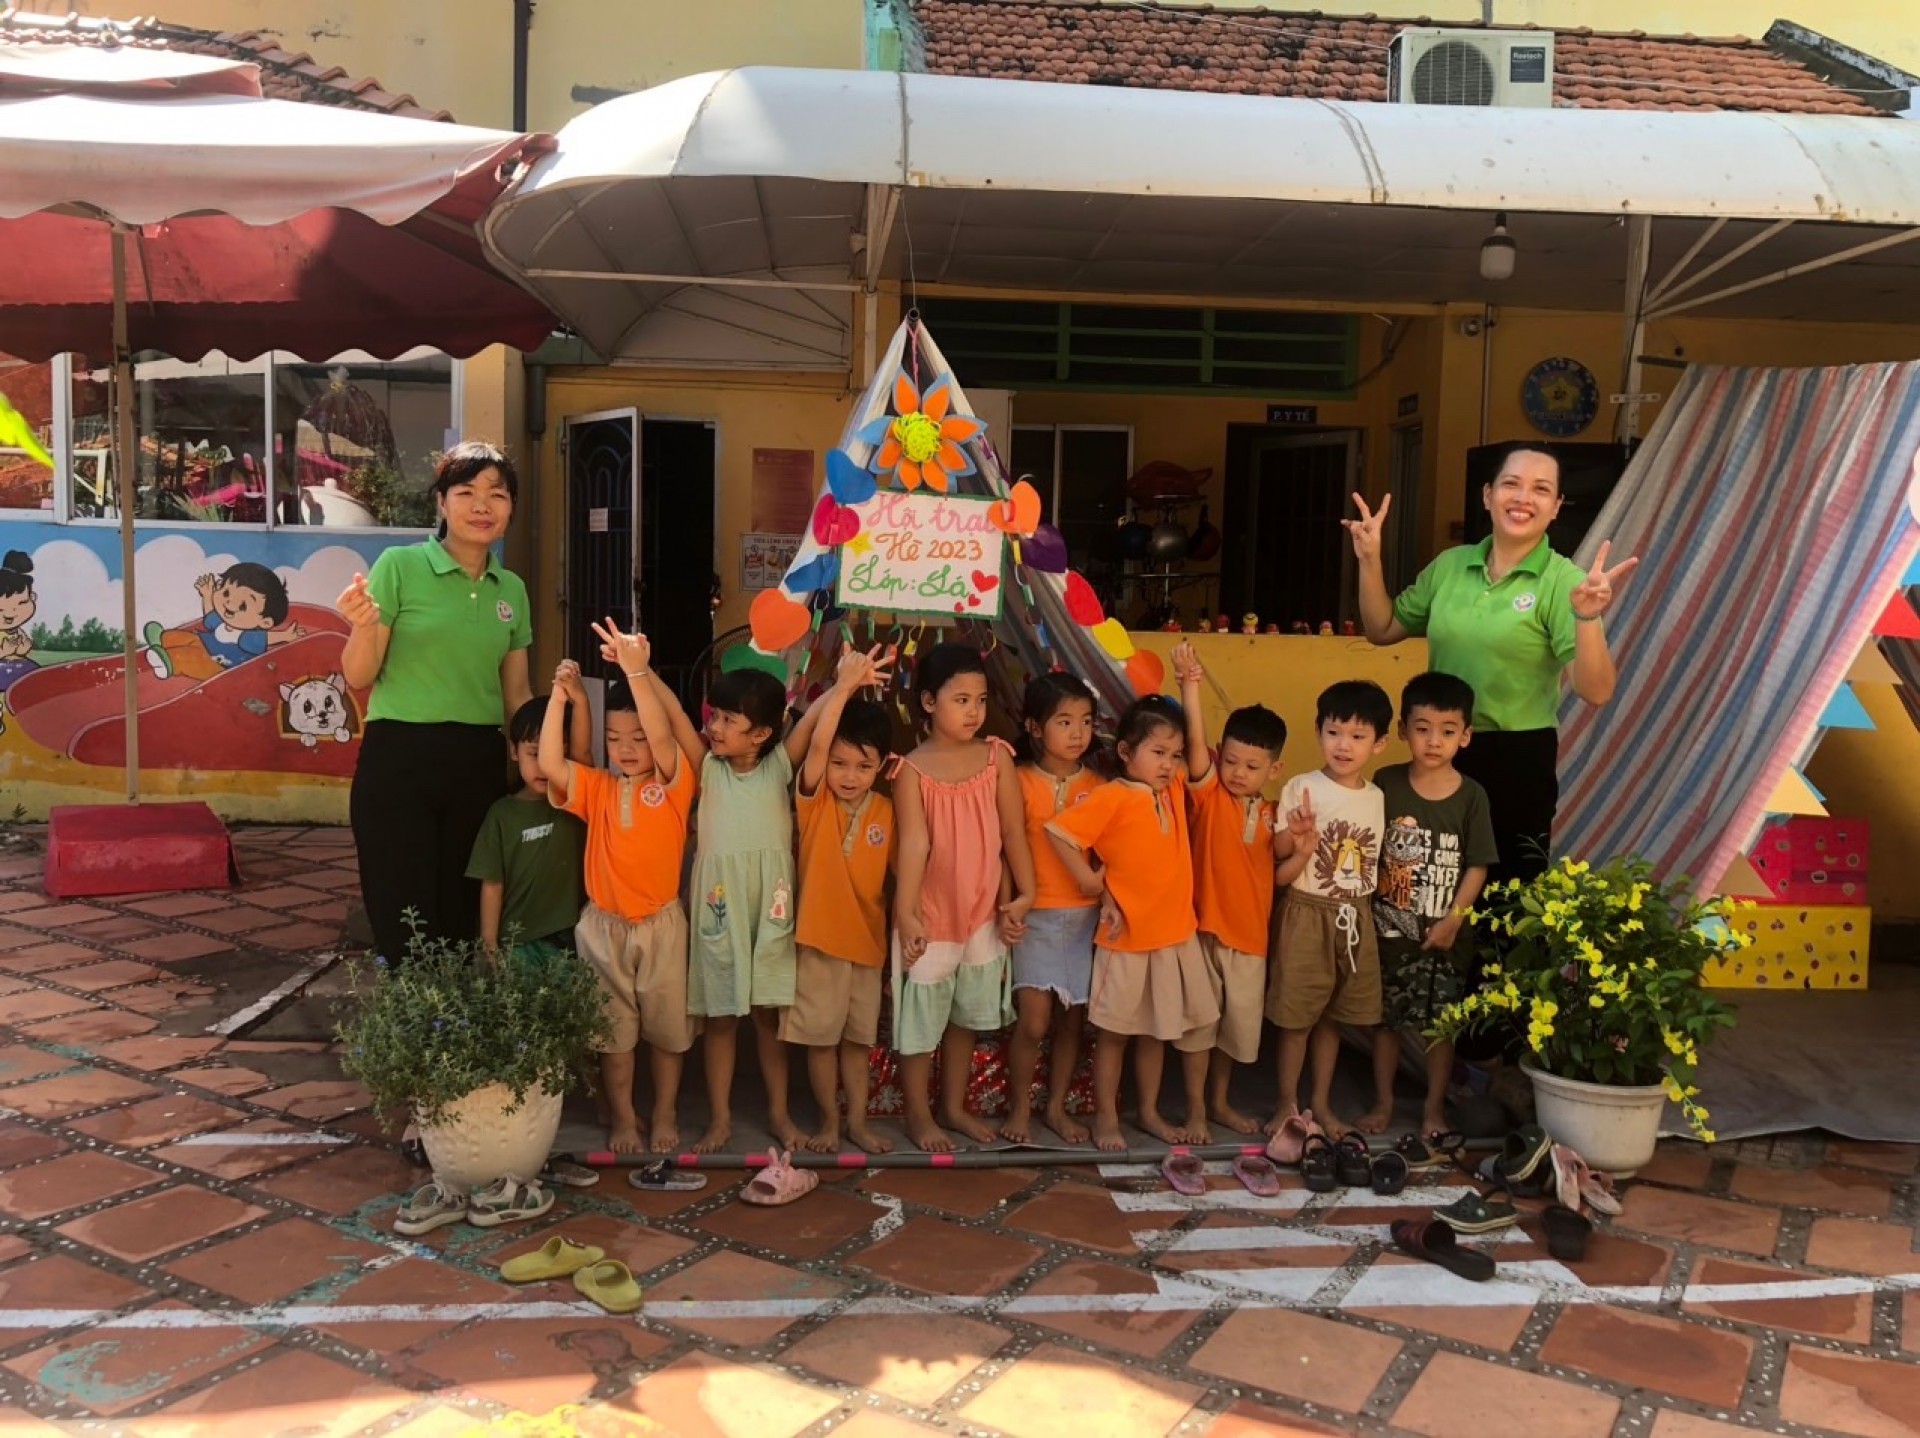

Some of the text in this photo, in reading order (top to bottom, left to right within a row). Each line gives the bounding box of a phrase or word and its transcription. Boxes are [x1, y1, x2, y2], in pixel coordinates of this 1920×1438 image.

[866, 492, 924, 530] Hội
[875, 531, 984, 562] Hè 2023
[918, 564, 970, 597] Lá
